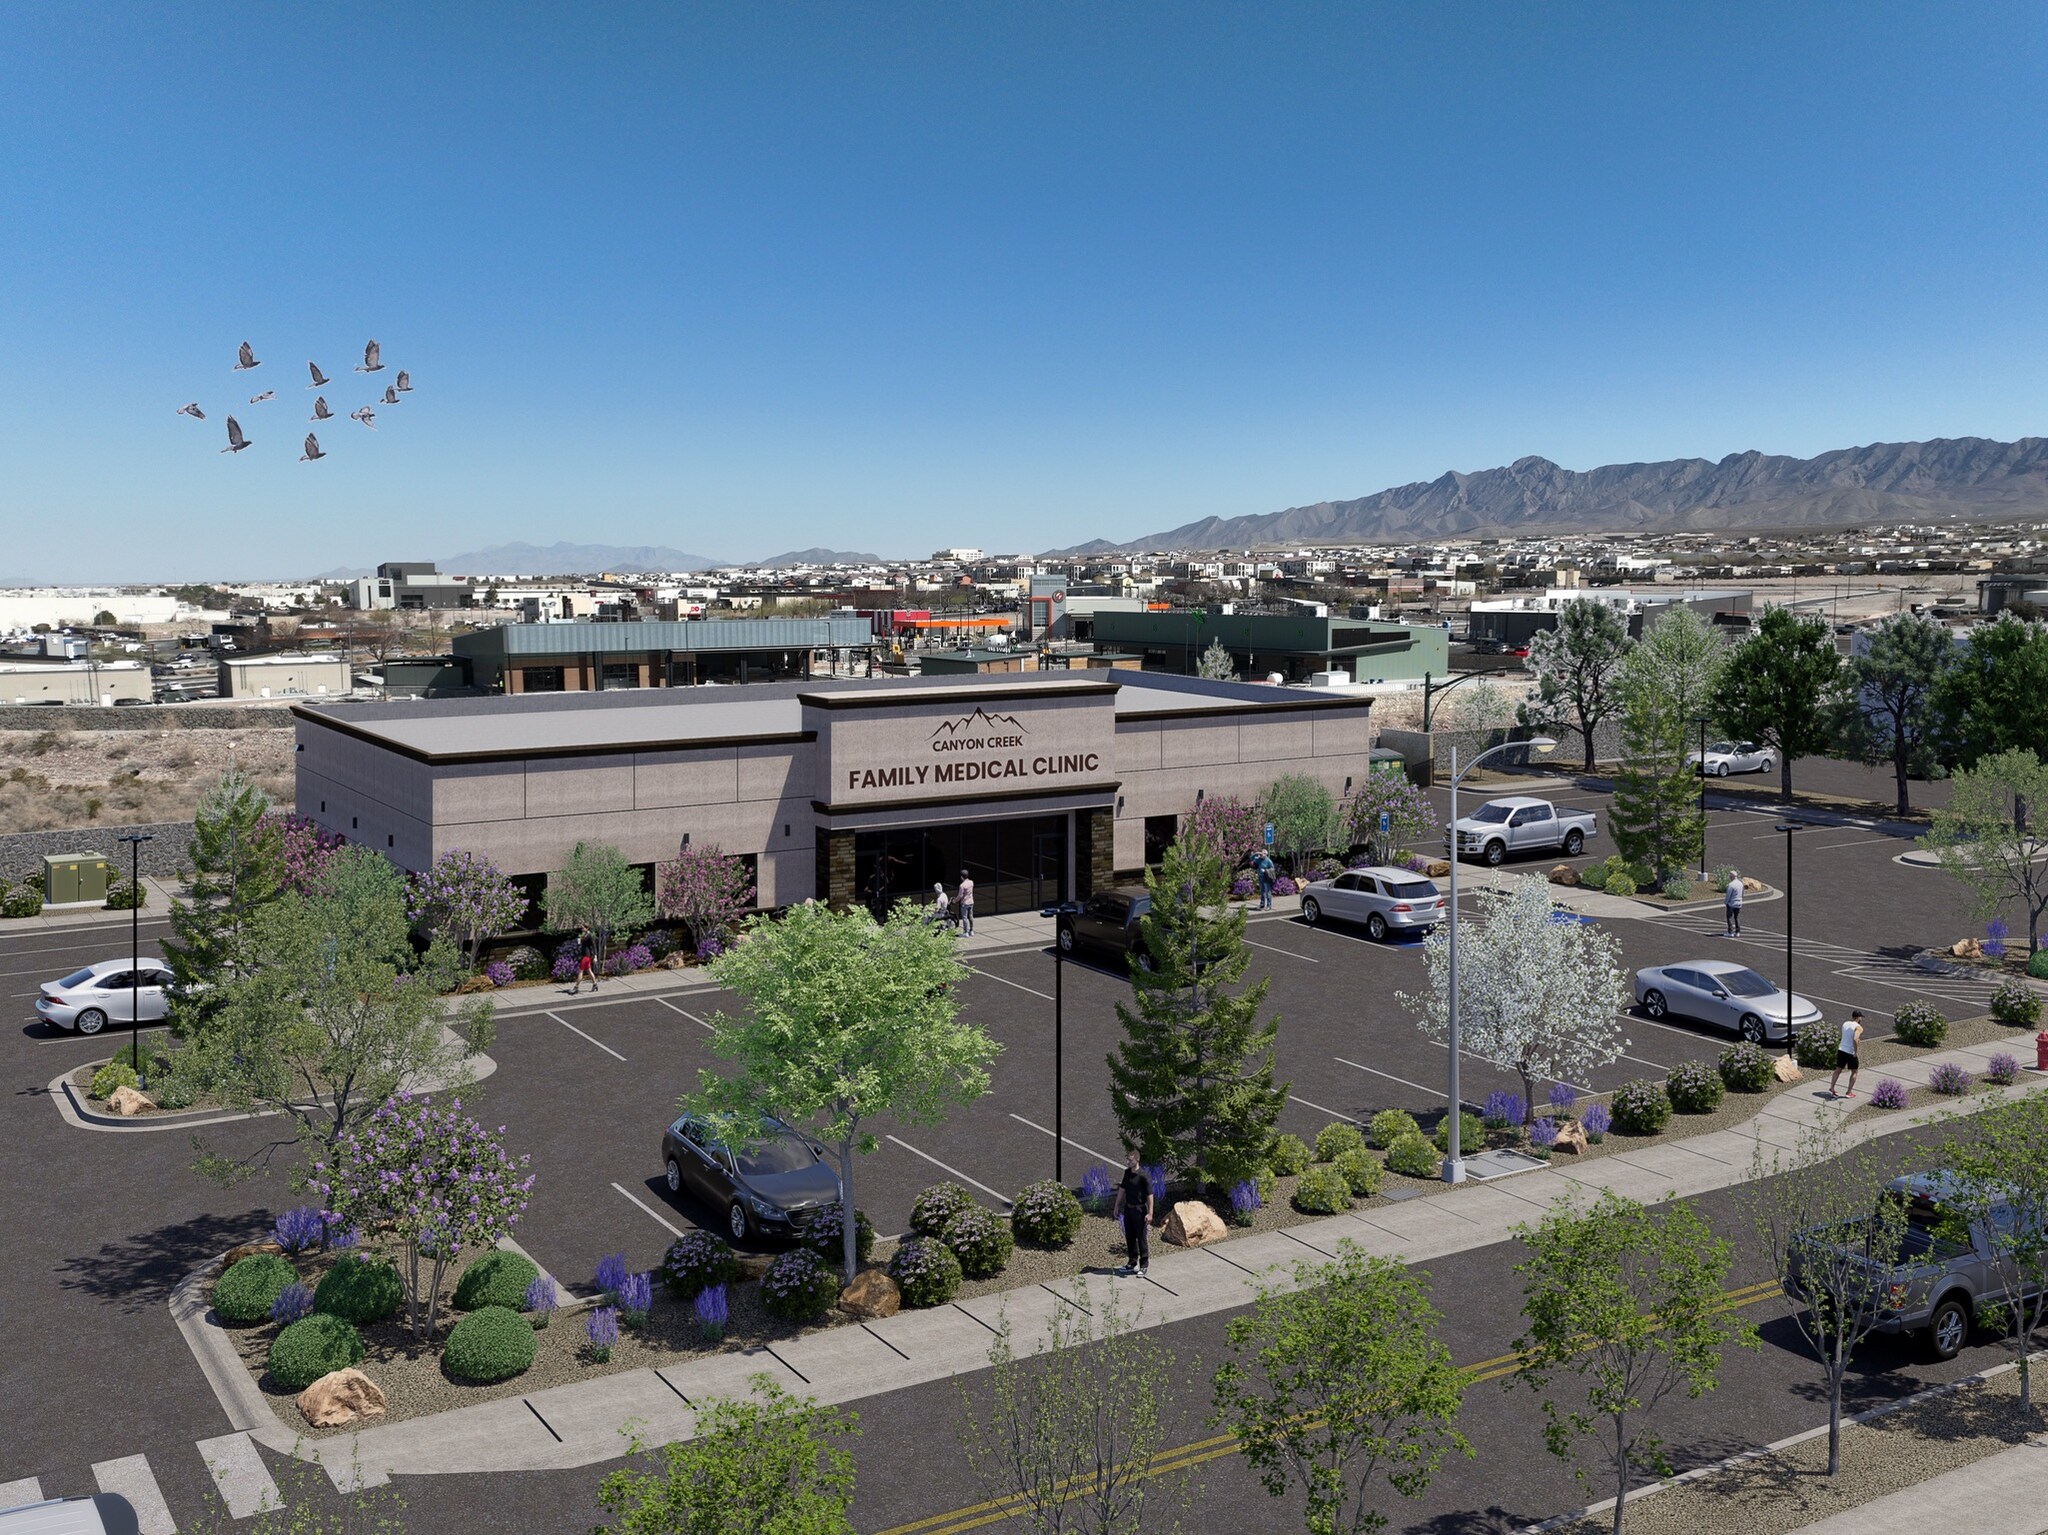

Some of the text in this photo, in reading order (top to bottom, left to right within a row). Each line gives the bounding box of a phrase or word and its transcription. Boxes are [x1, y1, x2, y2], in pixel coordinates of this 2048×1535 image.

[932, 735, 1023, 752] CANYON CREEK
[849, 753, 1099, 790] FAMILY MEDICAL CLINIC
